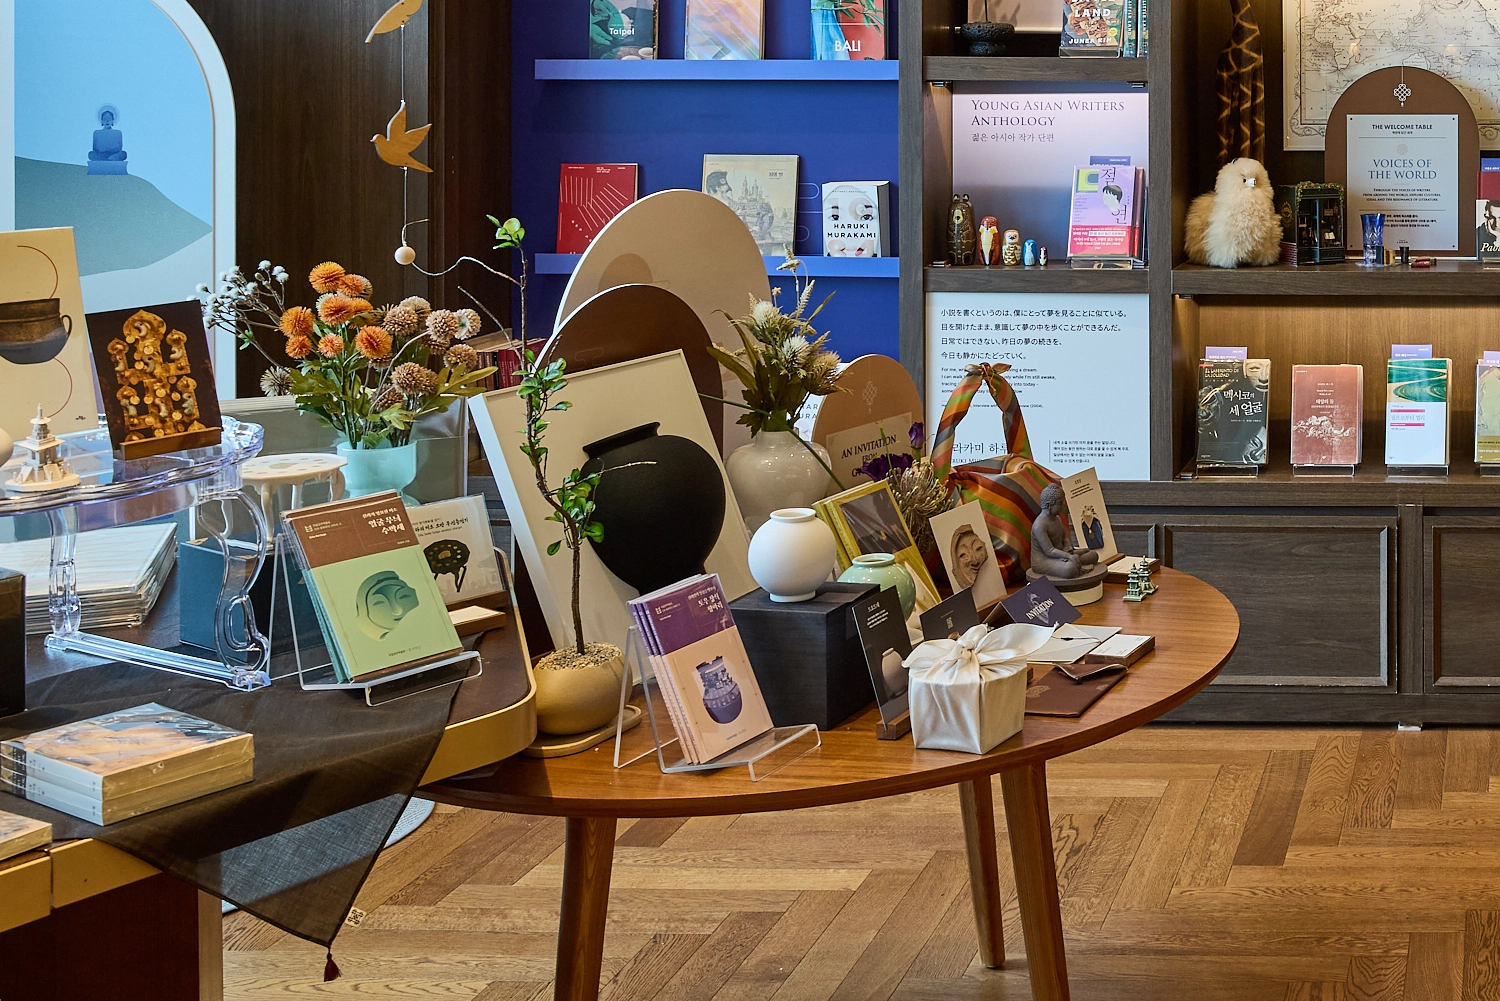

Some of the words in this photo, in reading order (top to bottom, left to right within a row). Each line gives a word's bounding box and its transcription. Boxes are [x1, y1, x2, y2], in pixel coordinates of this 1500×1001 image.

[1075, 8, 1111, 17] LAND
[834, 40, 861, 51] BALI
[971, 99, 1019, 111] YOUNG
[1023, 100, 1062, 111] ASIAN
[1067, 100, 1124, 111] WRITERS
[971, 115, 1055, 126] ANTHOLOGY
[972, 132, 988, 142] 젊은
[990, 132, 1016, 142] 아시아
[1018, 133, 1035, 142] 작가
[1038, 133, 1054, 142] 단편
[1373, 158, 1414, 168] VOICES
[1416, 159, 1432, 168] OF
[1368, 170, 1391, 180] THE
[1394, 170, 1437, 180] WORLD
[1229, 404, 1240, 416] 세
[1241, 401, 1262, 415] 얼굴
[841, 446, 853, 459] AN
